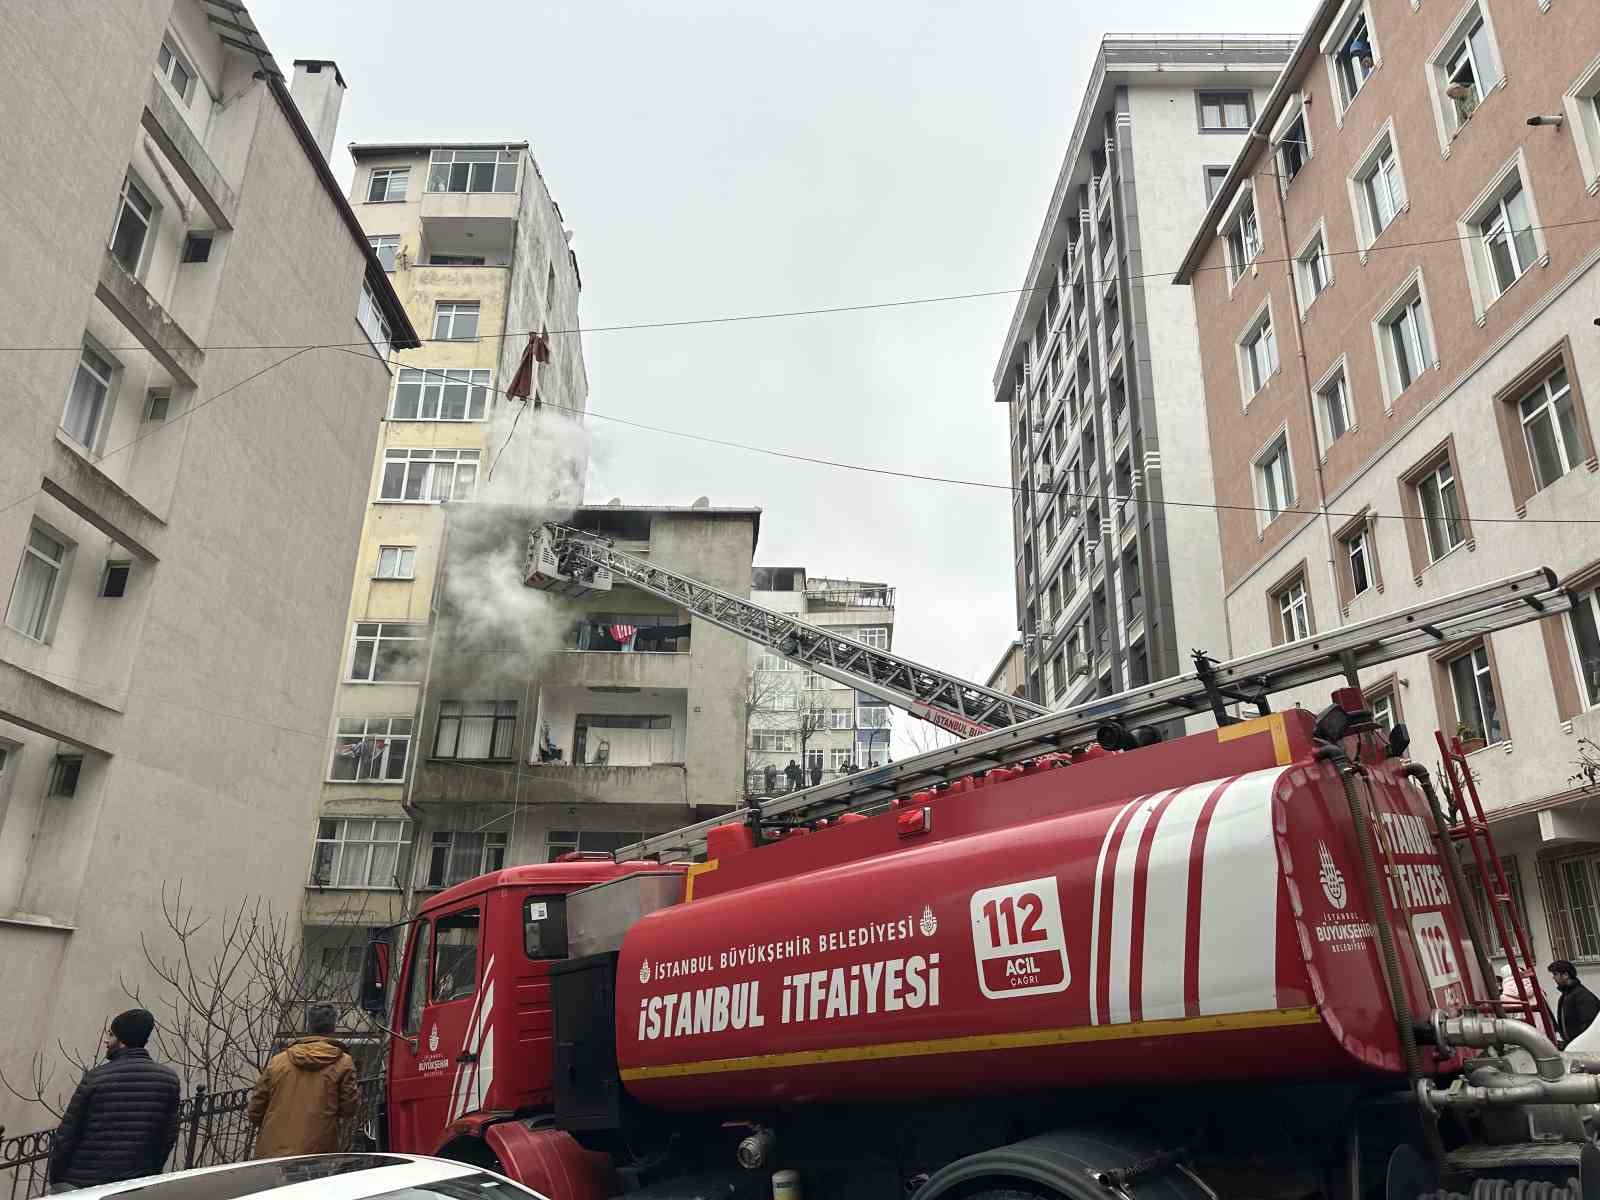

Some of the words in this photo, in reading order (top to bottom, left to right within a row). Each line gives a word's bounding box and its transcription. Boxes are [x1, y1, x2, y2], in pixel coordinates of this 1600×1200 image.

[655, 955, 714, 980] İSTANBUL
[720, 935, 811, 968] BÜYÜKŞEHİR
[819, 914, 914, 952] BELEDİYESİ
[982, 892, 1048, 948] 112
[1420, 925, 1454, 977] 112
[638, 980, 765, 1041] İSTANBUL
[781, 952, 940, 1025] İTFAİYESİ
